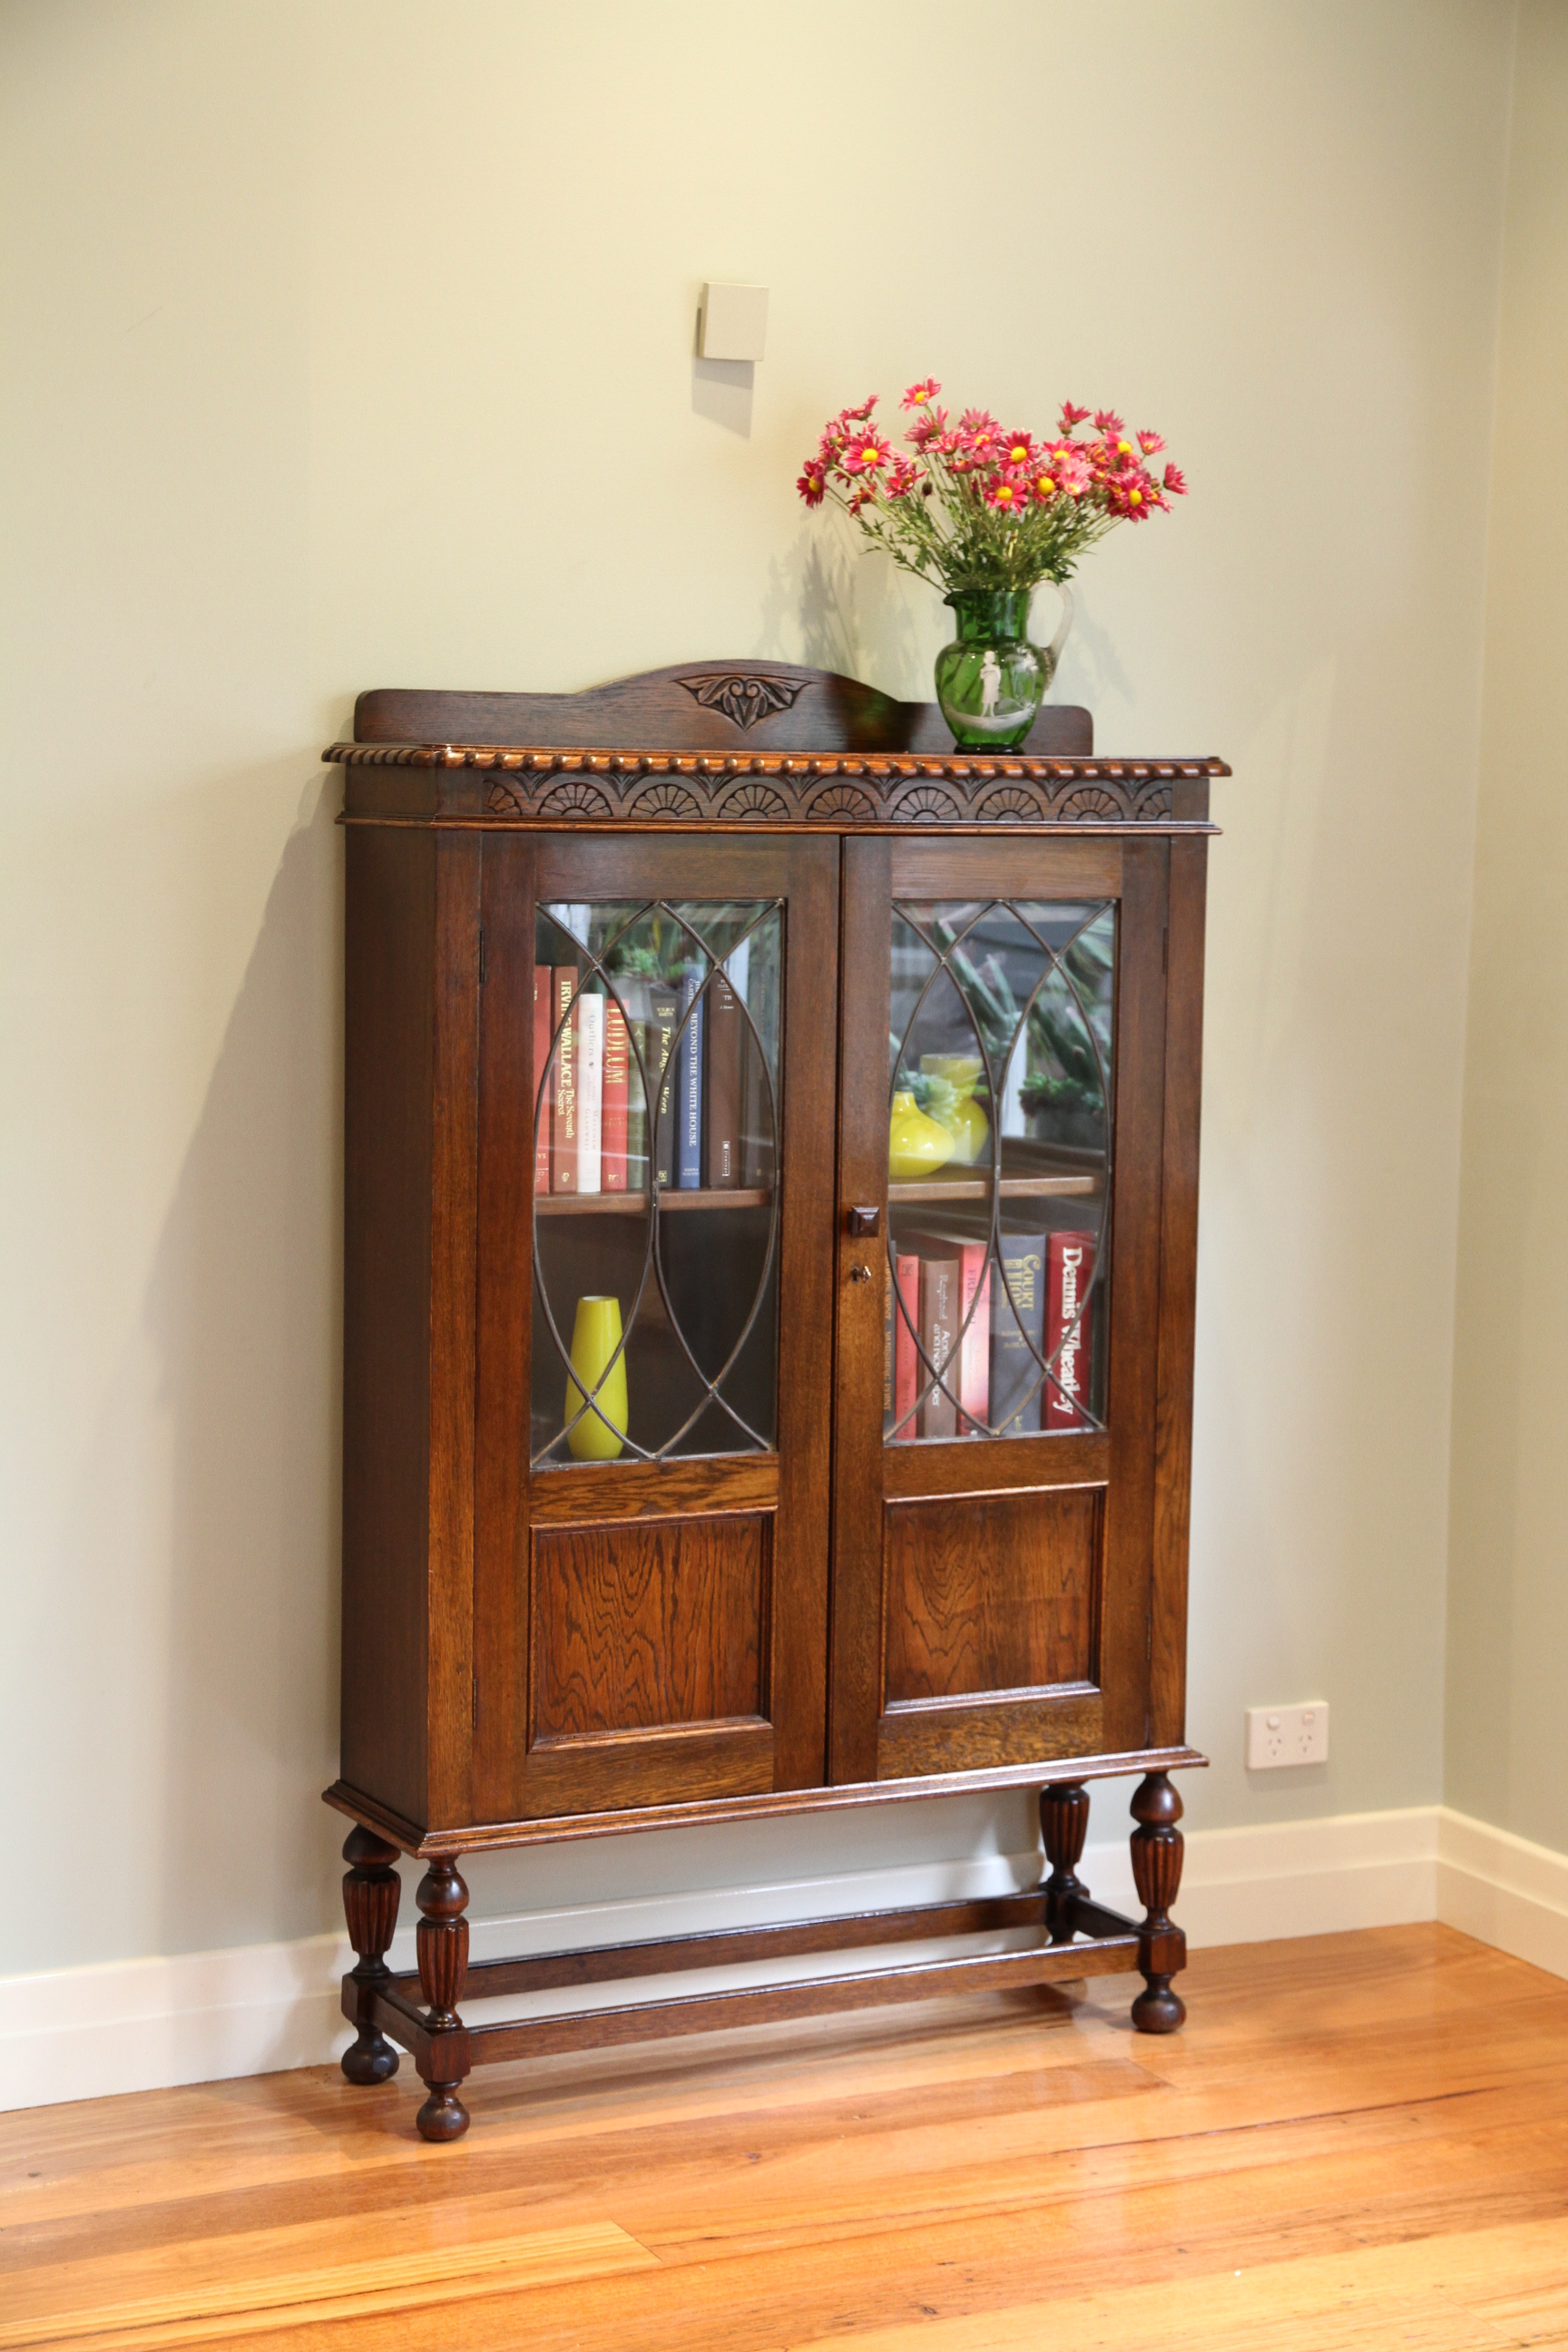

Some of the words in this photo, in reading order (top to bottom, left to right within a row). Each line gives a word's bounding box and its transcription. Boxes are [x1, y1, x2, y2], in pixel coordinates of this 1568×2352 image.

[587, 1014, 597, 1057] Outliers
[605, 1007, 629, 1084] LUDLUM
[661, 1027, 671, 1045] The
[689, 1013, 699, 1054] BEYOND
[559, 1026, 573, 1087] WALLACE
[689, 1054, 699, 1076] THE
[556, 1089, 566, 1117] Secret
[564, 1088, 576, 1105] The
[688, 1078, 699, 1111] WHITE
[564, 1105, 576, 1139] Seventh
[688, 1111, 699, 1147] HOUSE
[1023, 1254, 1043, 1310] COURT
[1062, 1246, 1083, 1319] Dennis
[933, 1324, 942, 1347] and
[1052, 1320, 1082, 1416] Wheatley
